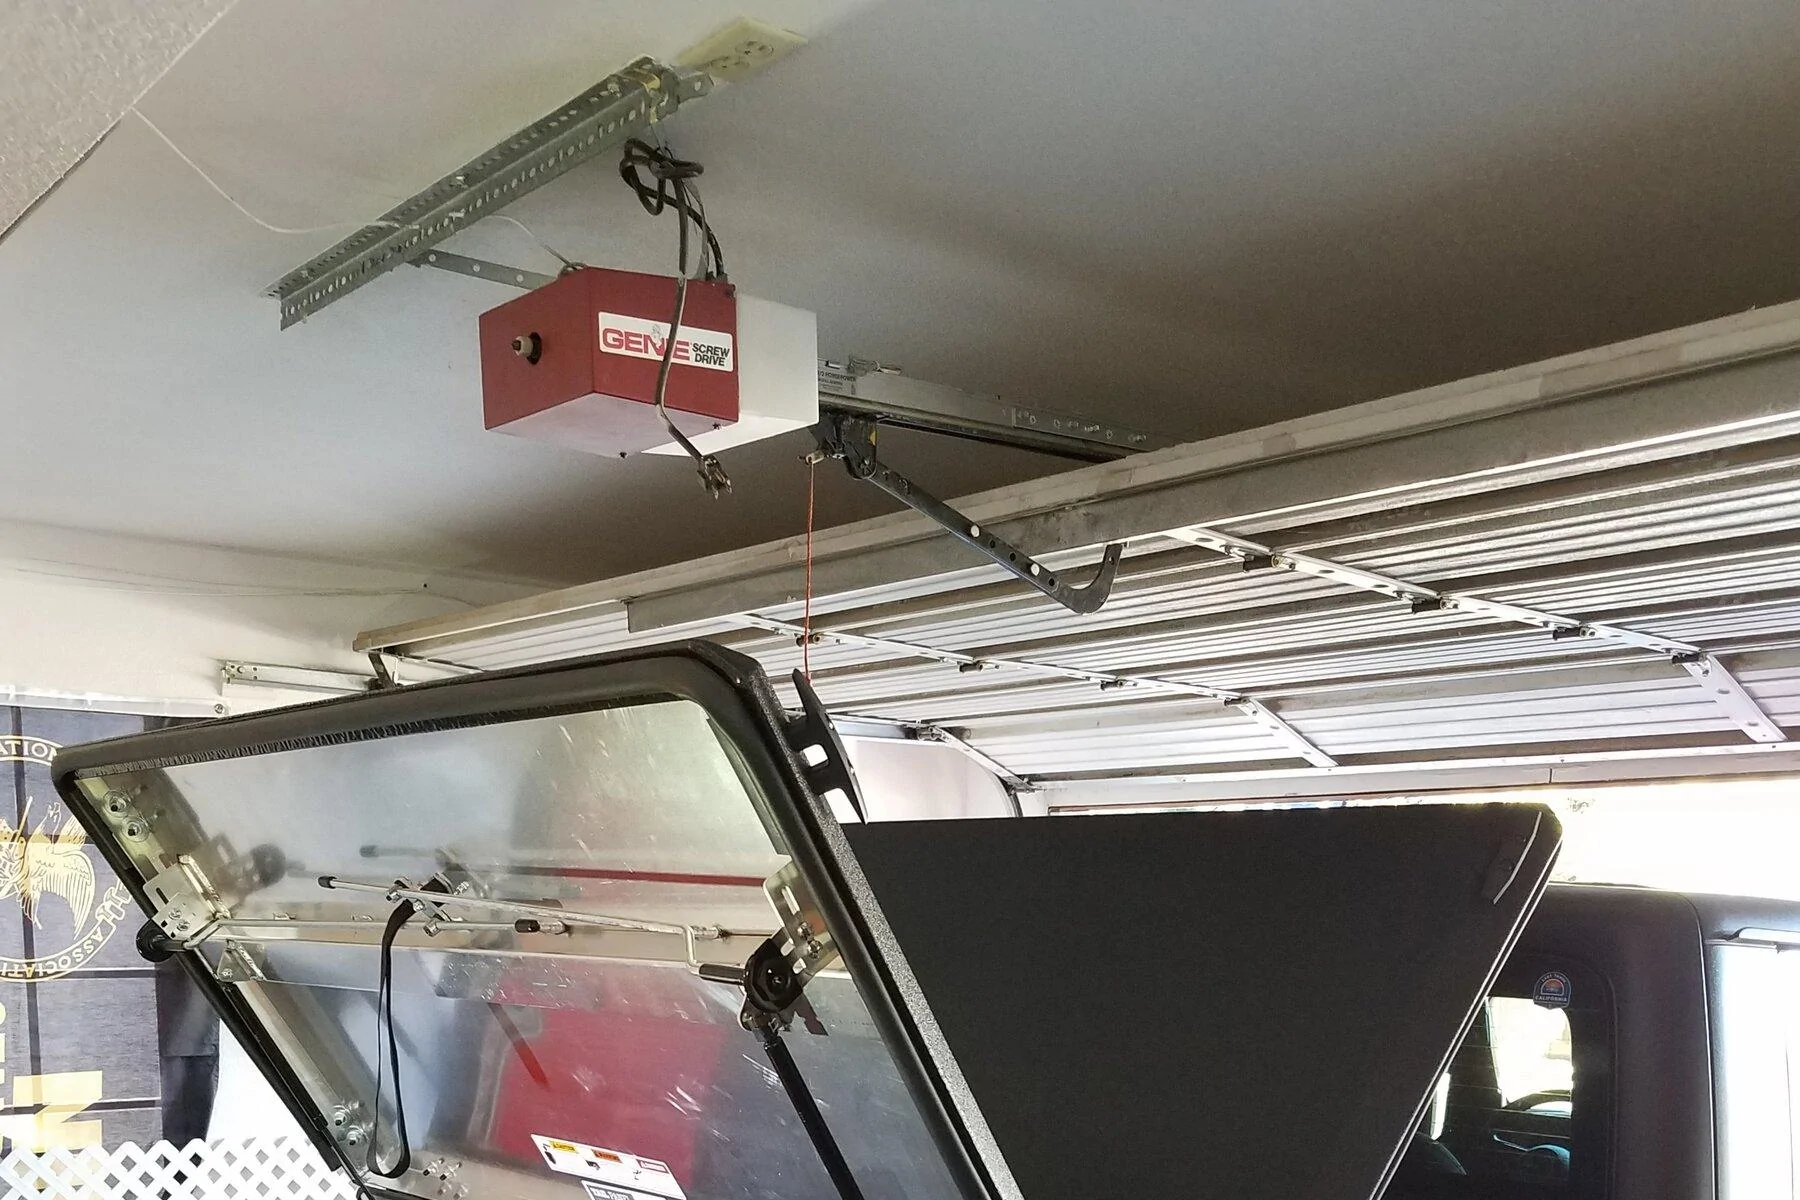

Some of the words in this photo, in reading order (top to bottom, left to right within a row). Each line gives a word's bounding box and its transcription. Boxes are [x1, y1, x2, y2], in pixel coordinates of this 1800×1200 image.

[602, 327, 690, 361] GENE
[692, 342, 730, 358] SCREW
[694, 353, 726, 367] DRIVE
